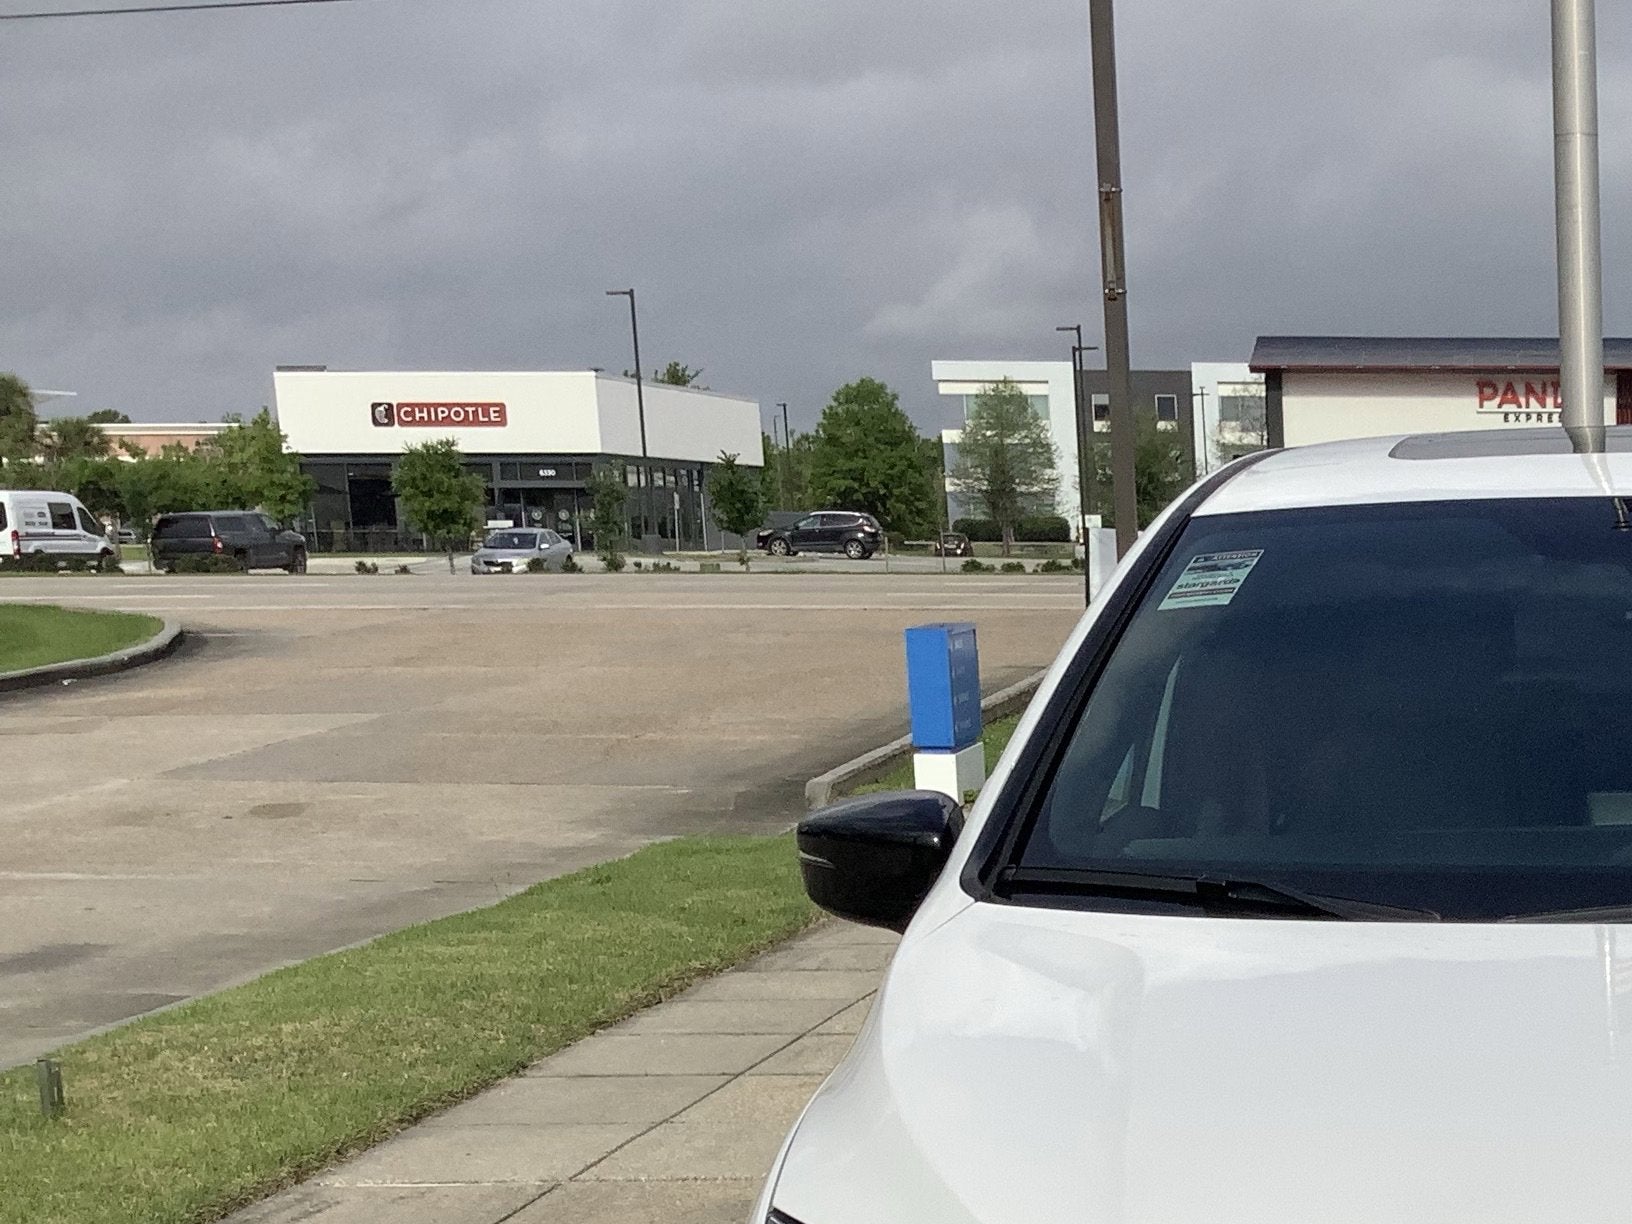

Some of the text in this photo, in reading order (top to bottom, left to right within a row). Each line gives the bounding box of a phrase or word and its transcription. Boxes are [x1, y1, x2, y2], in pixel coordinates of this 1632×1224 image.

[1476, 381, 1563, 409] PAN
[400, 407, 502, 422] CHIPOTLE
[1503, 412, 1562, 423] EXPRE
